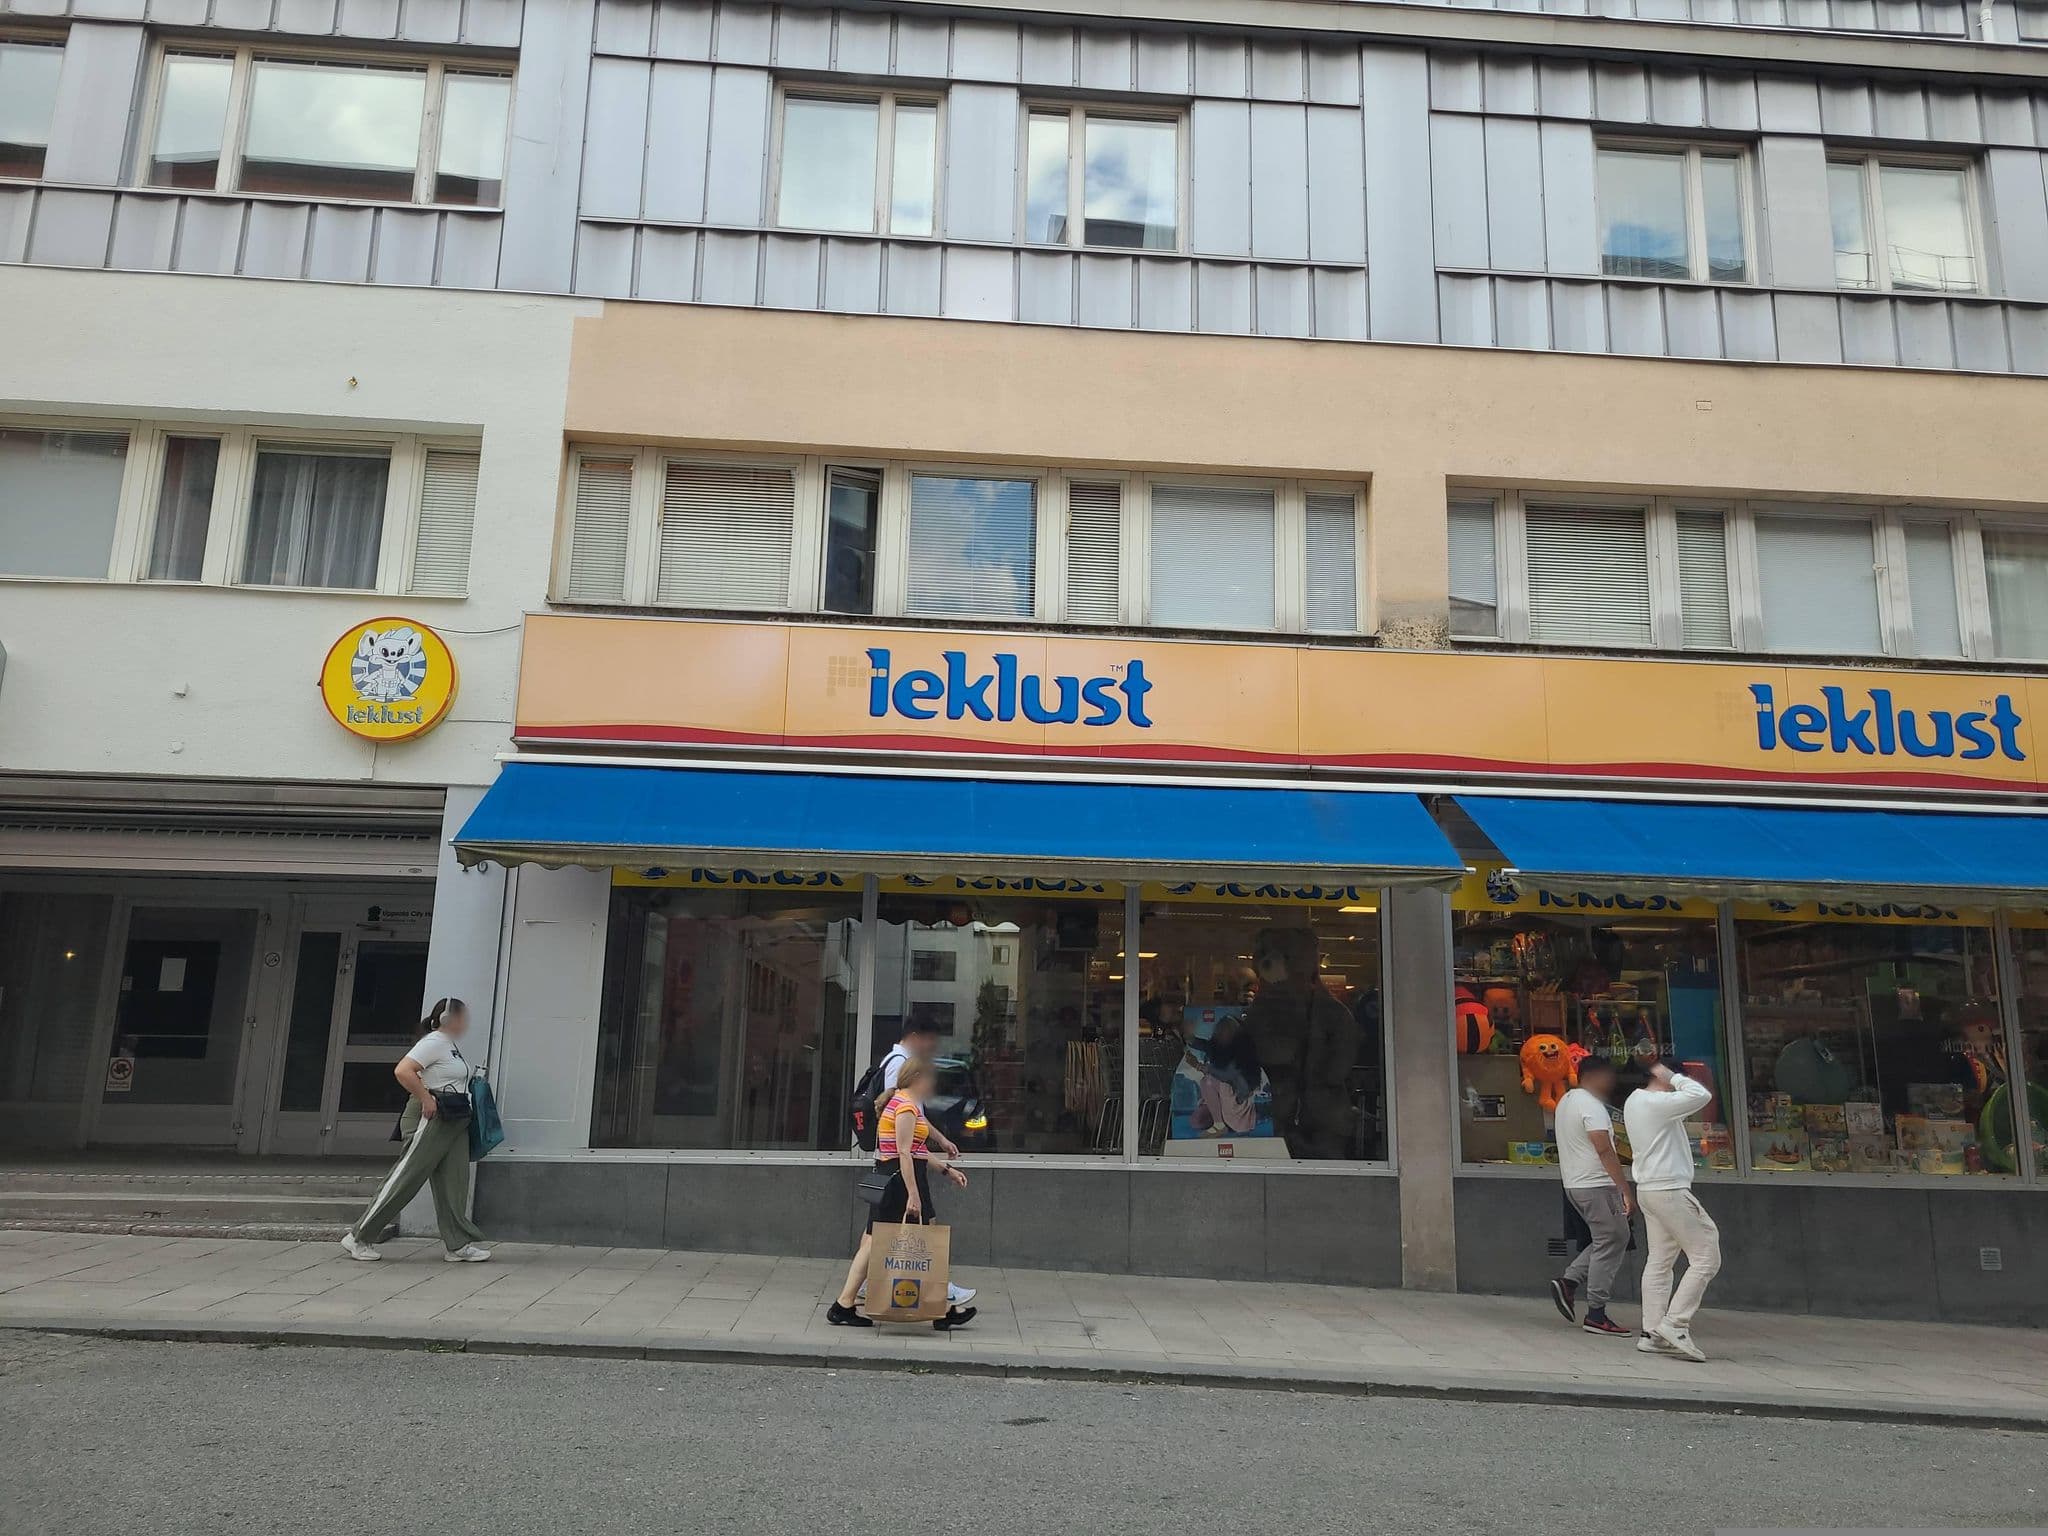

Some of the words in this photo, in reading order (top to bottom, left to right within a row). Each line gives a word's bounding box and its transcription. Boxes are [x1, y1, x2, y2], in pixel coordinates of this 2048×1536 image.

[865, 647, 1154, 728] leklust
[346, 704, 424, 724] leklust
[1748, 684, 2027, 762] leklust
[884, 1256, 933, 1272] MATRIKET
